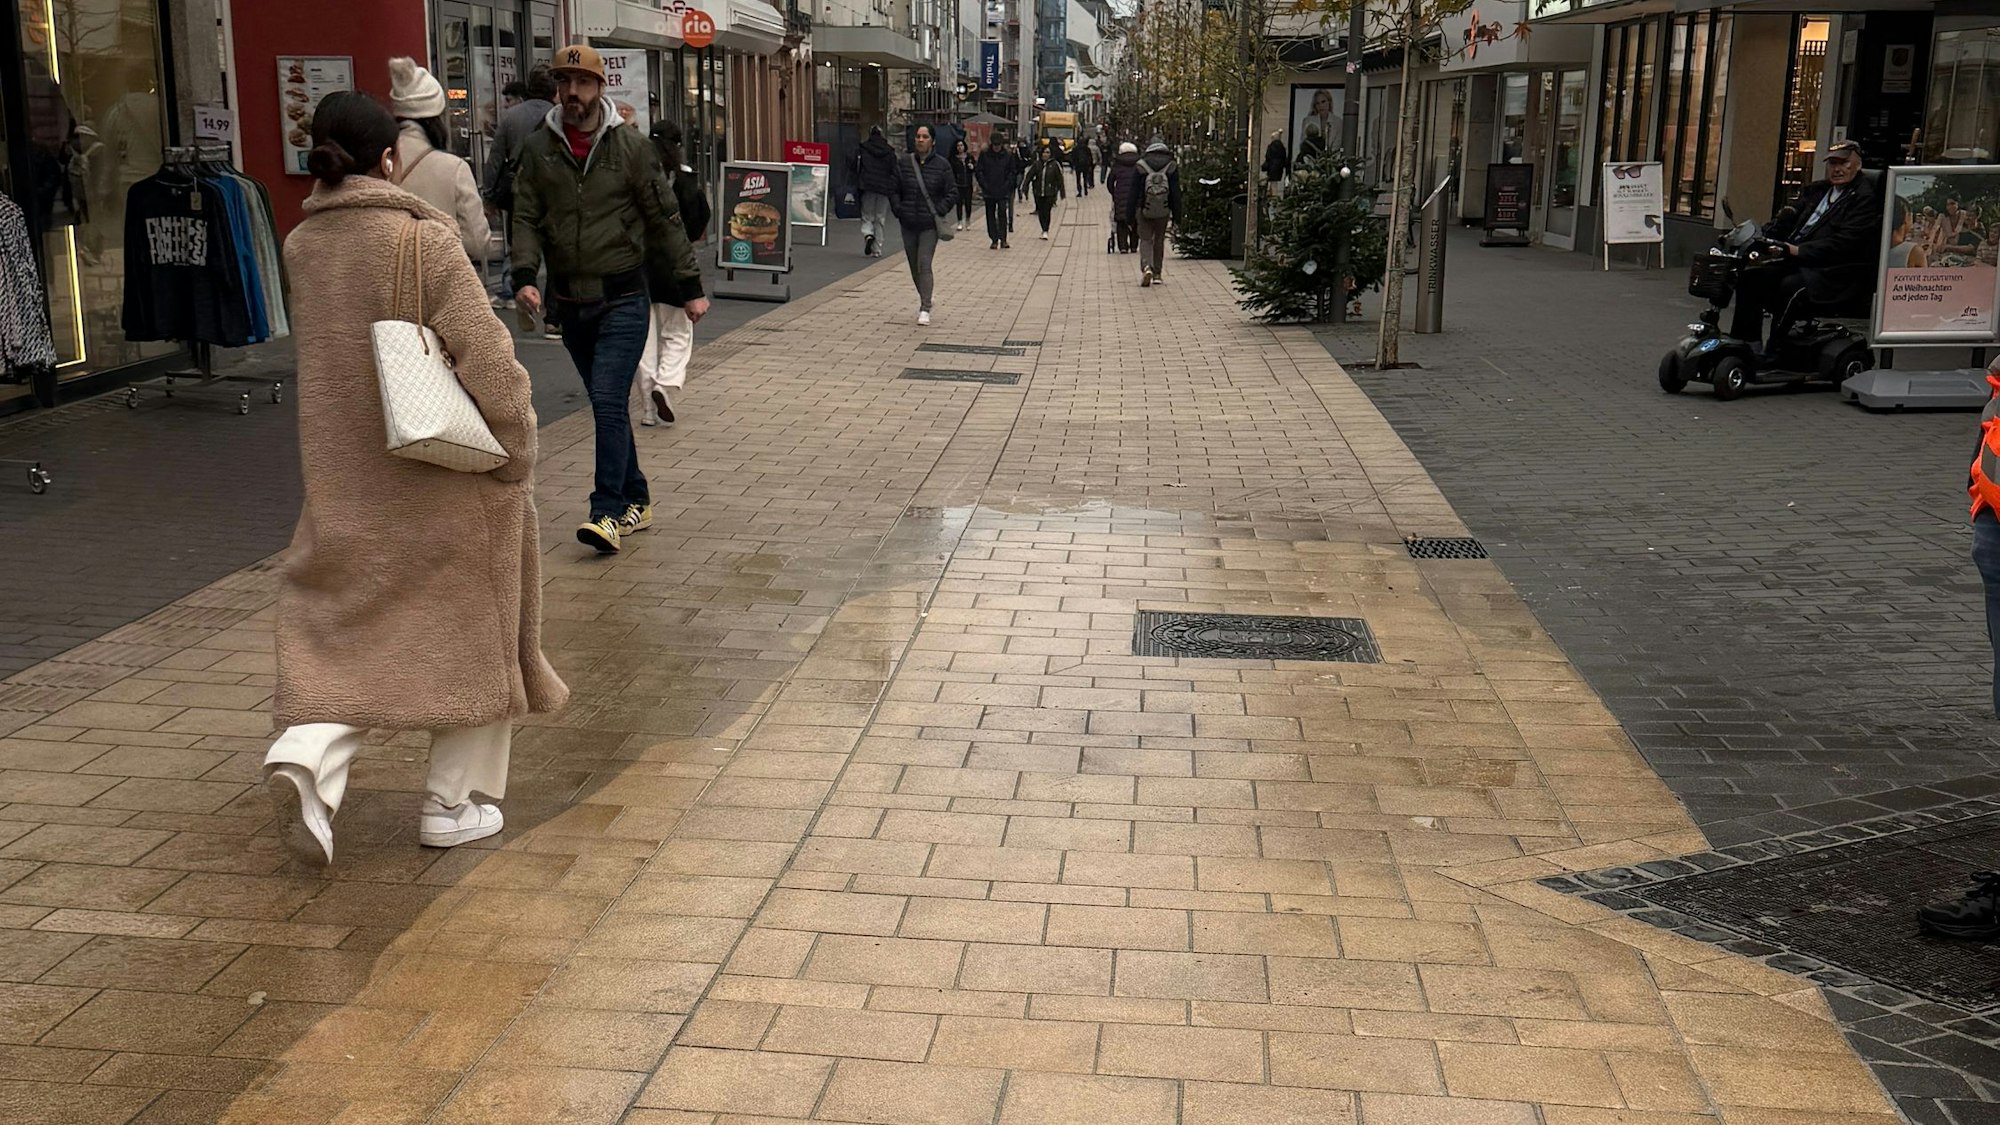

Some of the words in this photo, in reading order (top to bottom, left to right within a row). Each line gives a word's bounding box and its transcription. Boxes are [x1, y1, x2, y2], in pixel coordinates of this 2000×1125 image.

[685, 15, 712, 33] ria
[986, 55, 995, 85] Thalia
[202, 118, 230, 132] 14.99
[743, 175, 766, 190] ASIA
[1427, 218, 1440, 295] TRINKWASSER
[1894, 274, 1921, 282] Kommt
[1892, 284, 1903, 292] An
[1904, 284, 1952, 292] Weihnachten
[1892, 292, 1907, 301] und
[1907, 293, 1929, 303] jeden
[1930, 293, 1943, 303] Tag
[1963, 306, 1978, 316] dm
